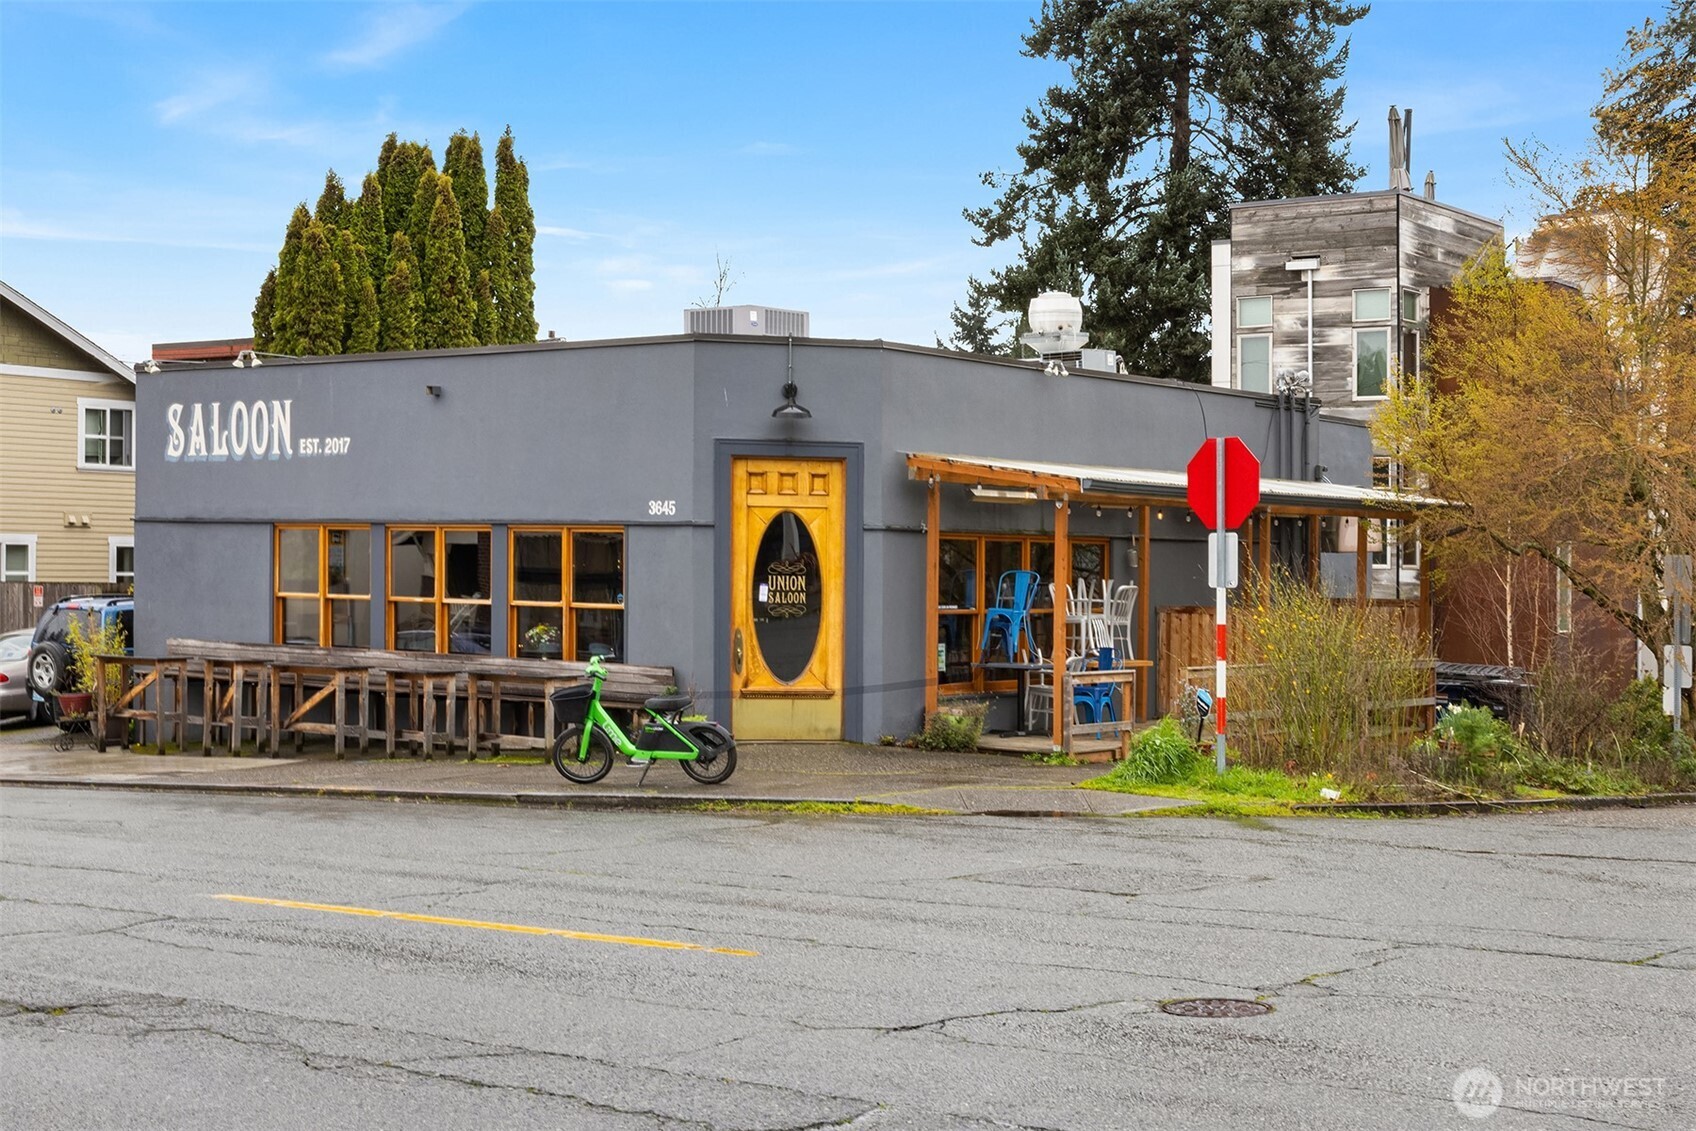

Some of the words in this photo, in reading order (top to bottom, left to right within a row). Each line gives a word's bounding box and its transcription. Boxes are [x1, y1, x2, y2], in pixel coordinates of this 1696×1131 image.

[165, 400, 293, 461] SALOON
[299, 438, 322, 455] EST.
[325, 437, 351, 455] 2017
[648, 500, 676, 515] 3645
[768, 575, 806, 591] UNION
[768, 592, 806, 603] SALOON
